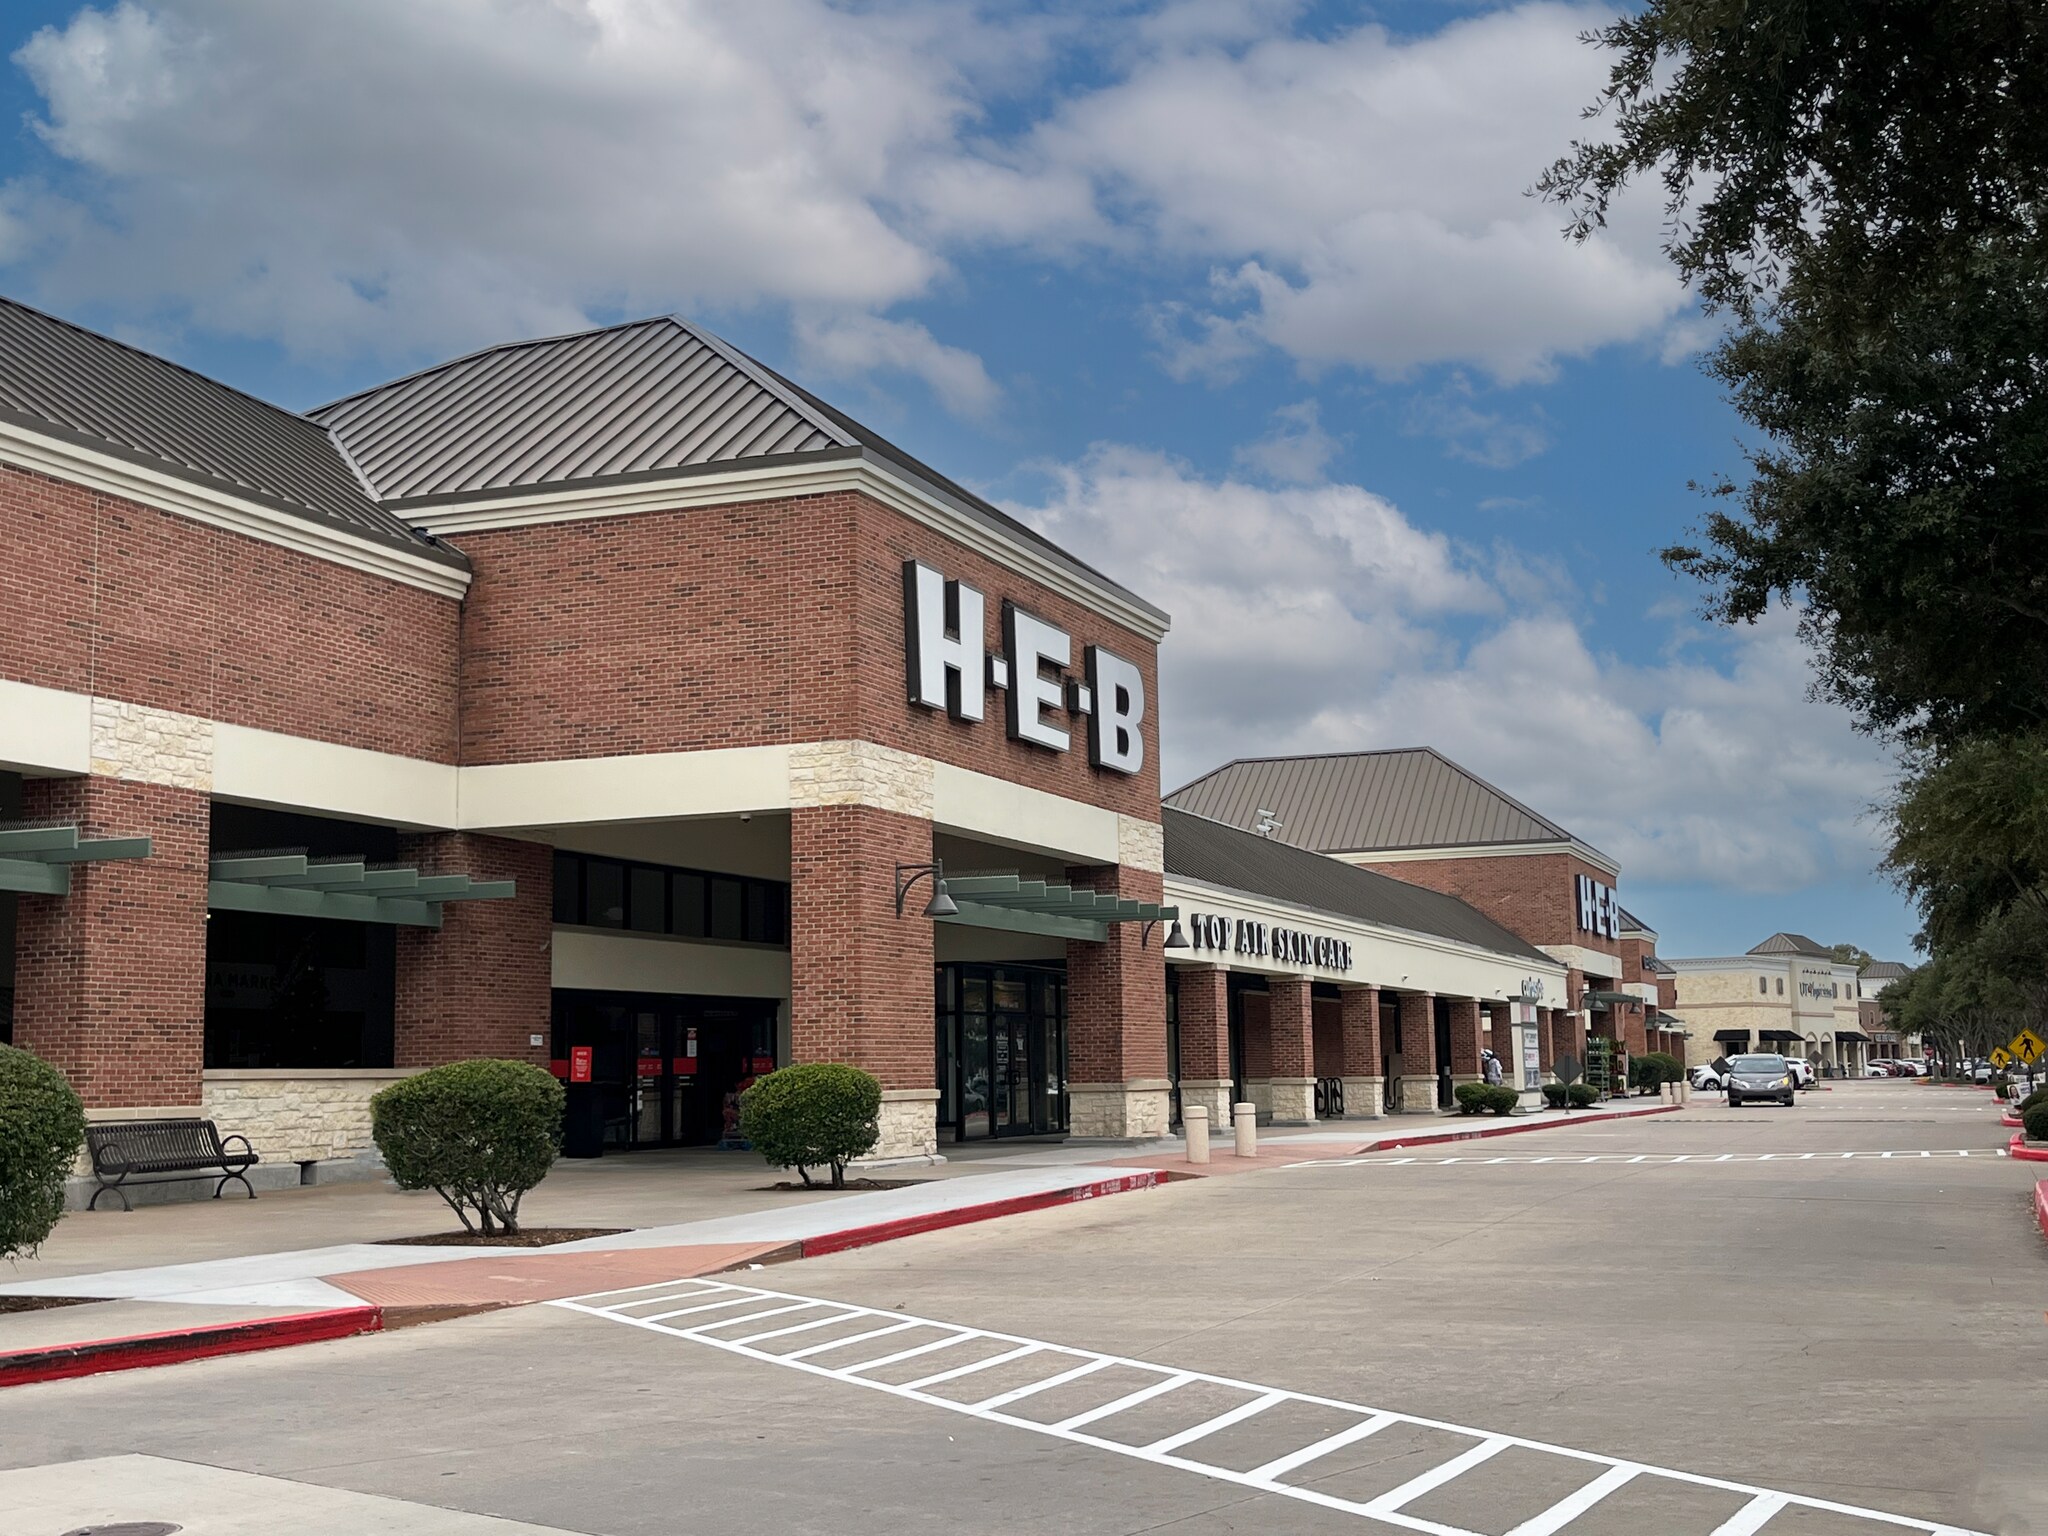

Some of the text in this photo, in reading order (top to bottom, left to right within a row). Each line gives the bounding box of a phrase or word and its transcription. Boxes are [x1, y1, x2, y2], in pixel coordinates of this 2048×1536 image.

[903, 559, 1145, 775] H-E-B
[1575, 875, 1620, 939] H-E-B
[1191, 913, 1352, 970] TOP AIR SKIN CARE
